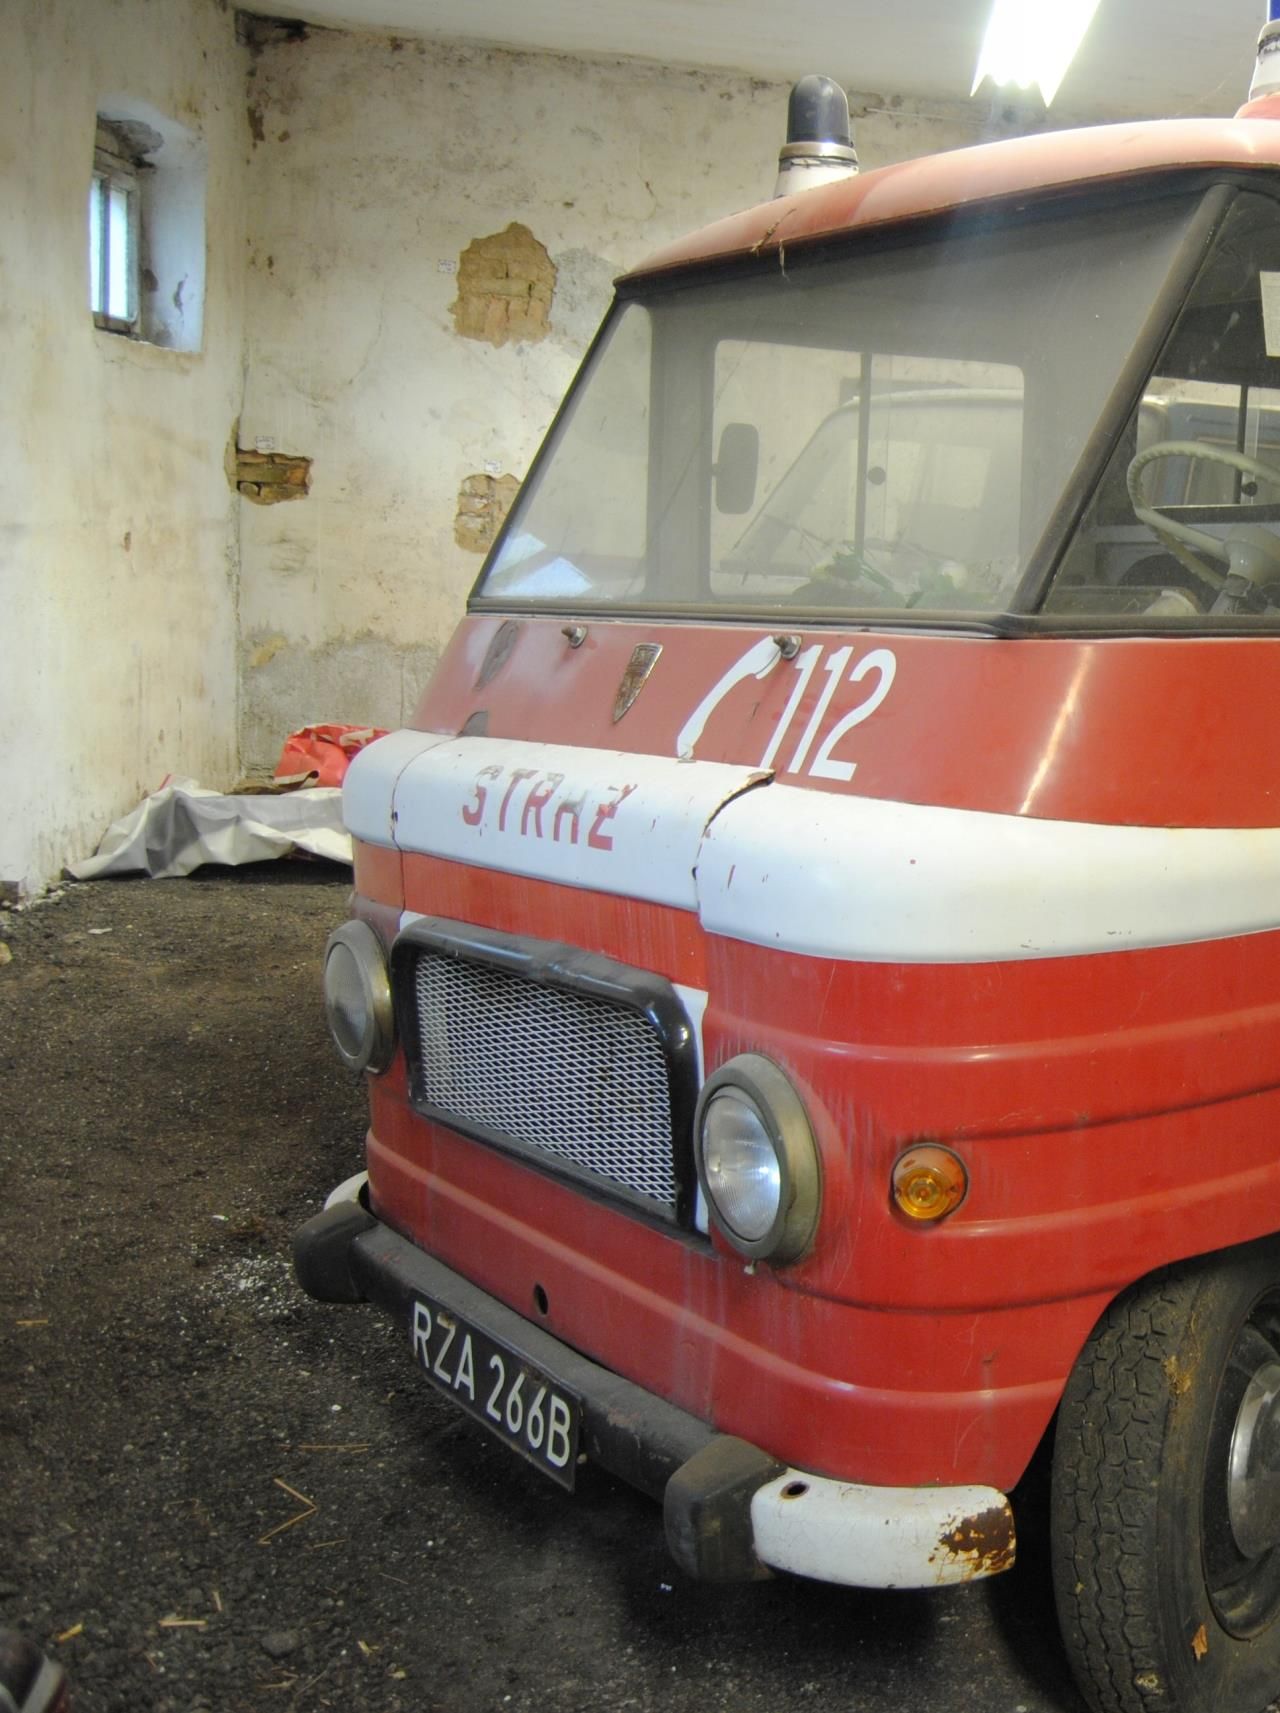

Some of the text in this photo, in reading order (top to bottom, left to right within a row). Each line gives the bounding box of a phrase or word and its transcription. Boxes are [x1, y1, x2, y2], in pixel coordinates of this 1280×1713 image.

[760, 644, 897, 782] 112
[412, 1300, 571, 1468] RZA 266B
